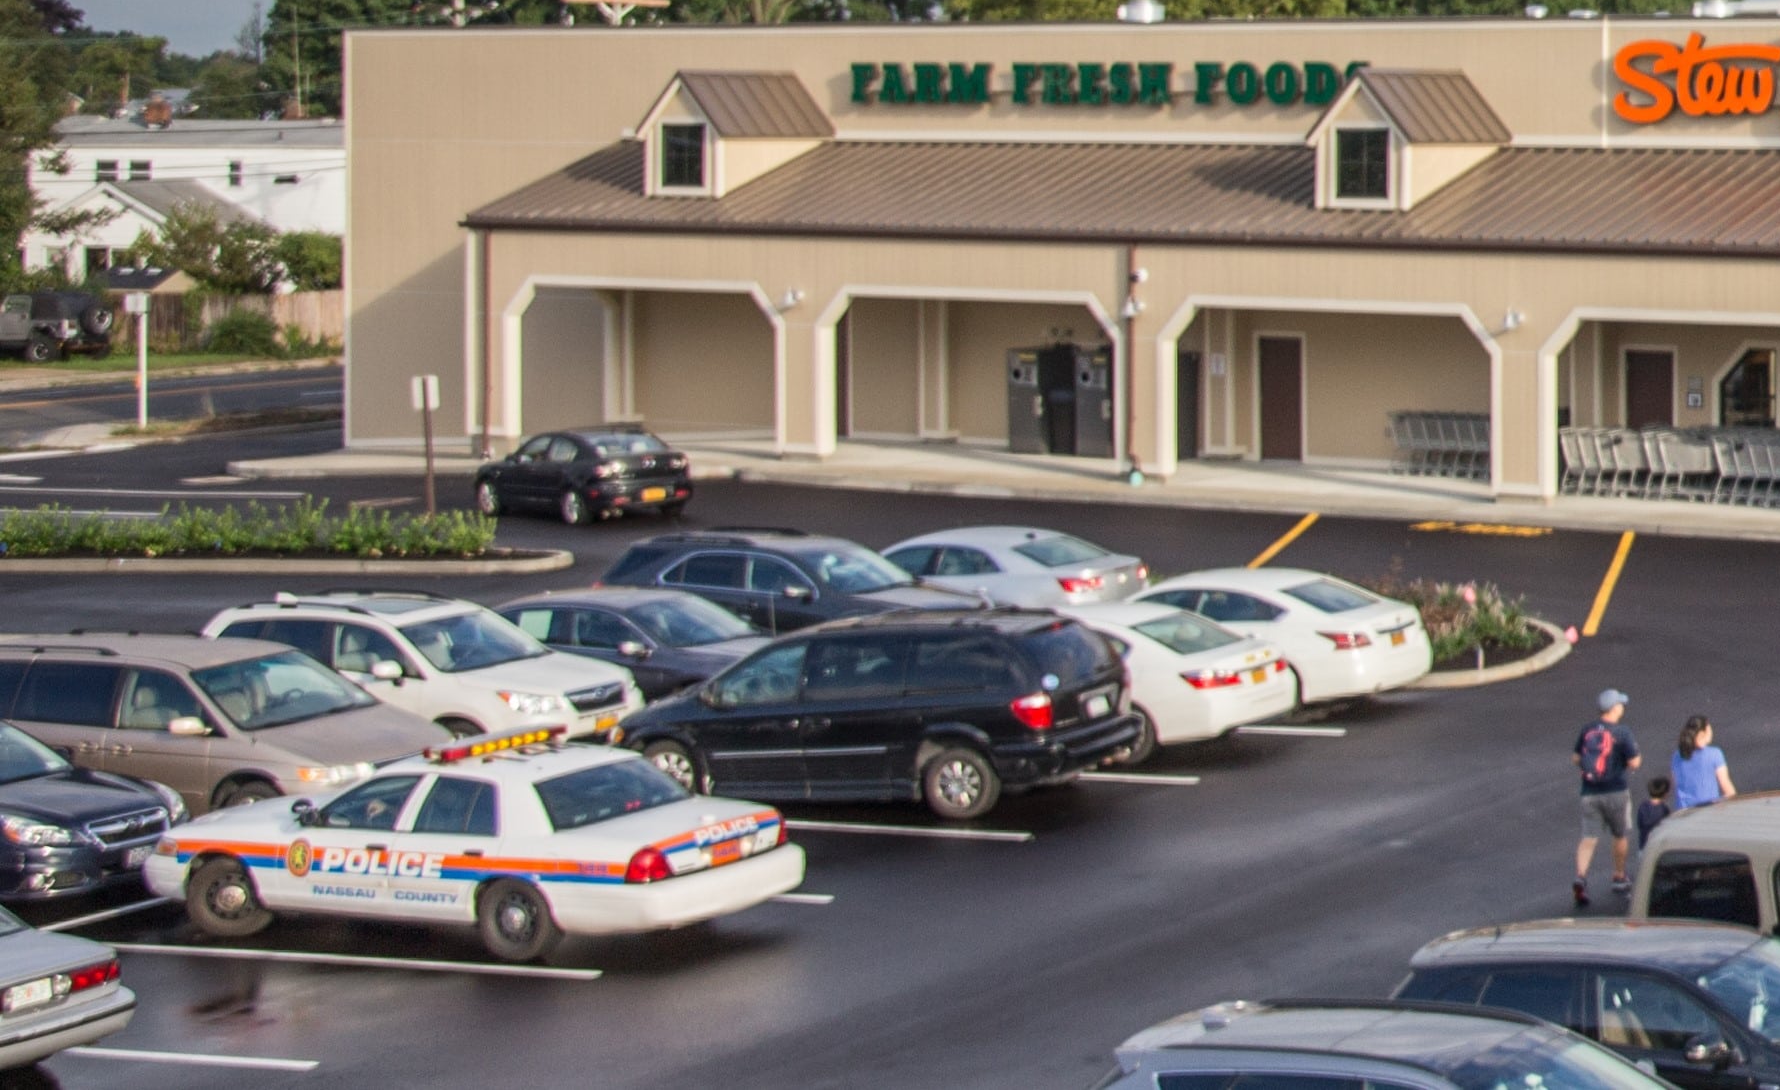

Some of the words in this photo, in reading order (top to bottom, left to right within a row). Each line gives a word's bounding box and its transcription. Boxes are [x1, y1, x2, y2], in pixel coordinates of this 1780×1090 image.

[850, 61, 991, 105] FARM
[1011, 61, 1175, 106] FRESH
[694, 816, 760, 846] POLICE
[320, 847, 445, 879] POLICE
[312, 884, 376, 899] NASSAU
[394, 889, 459, 903] COUNTY
